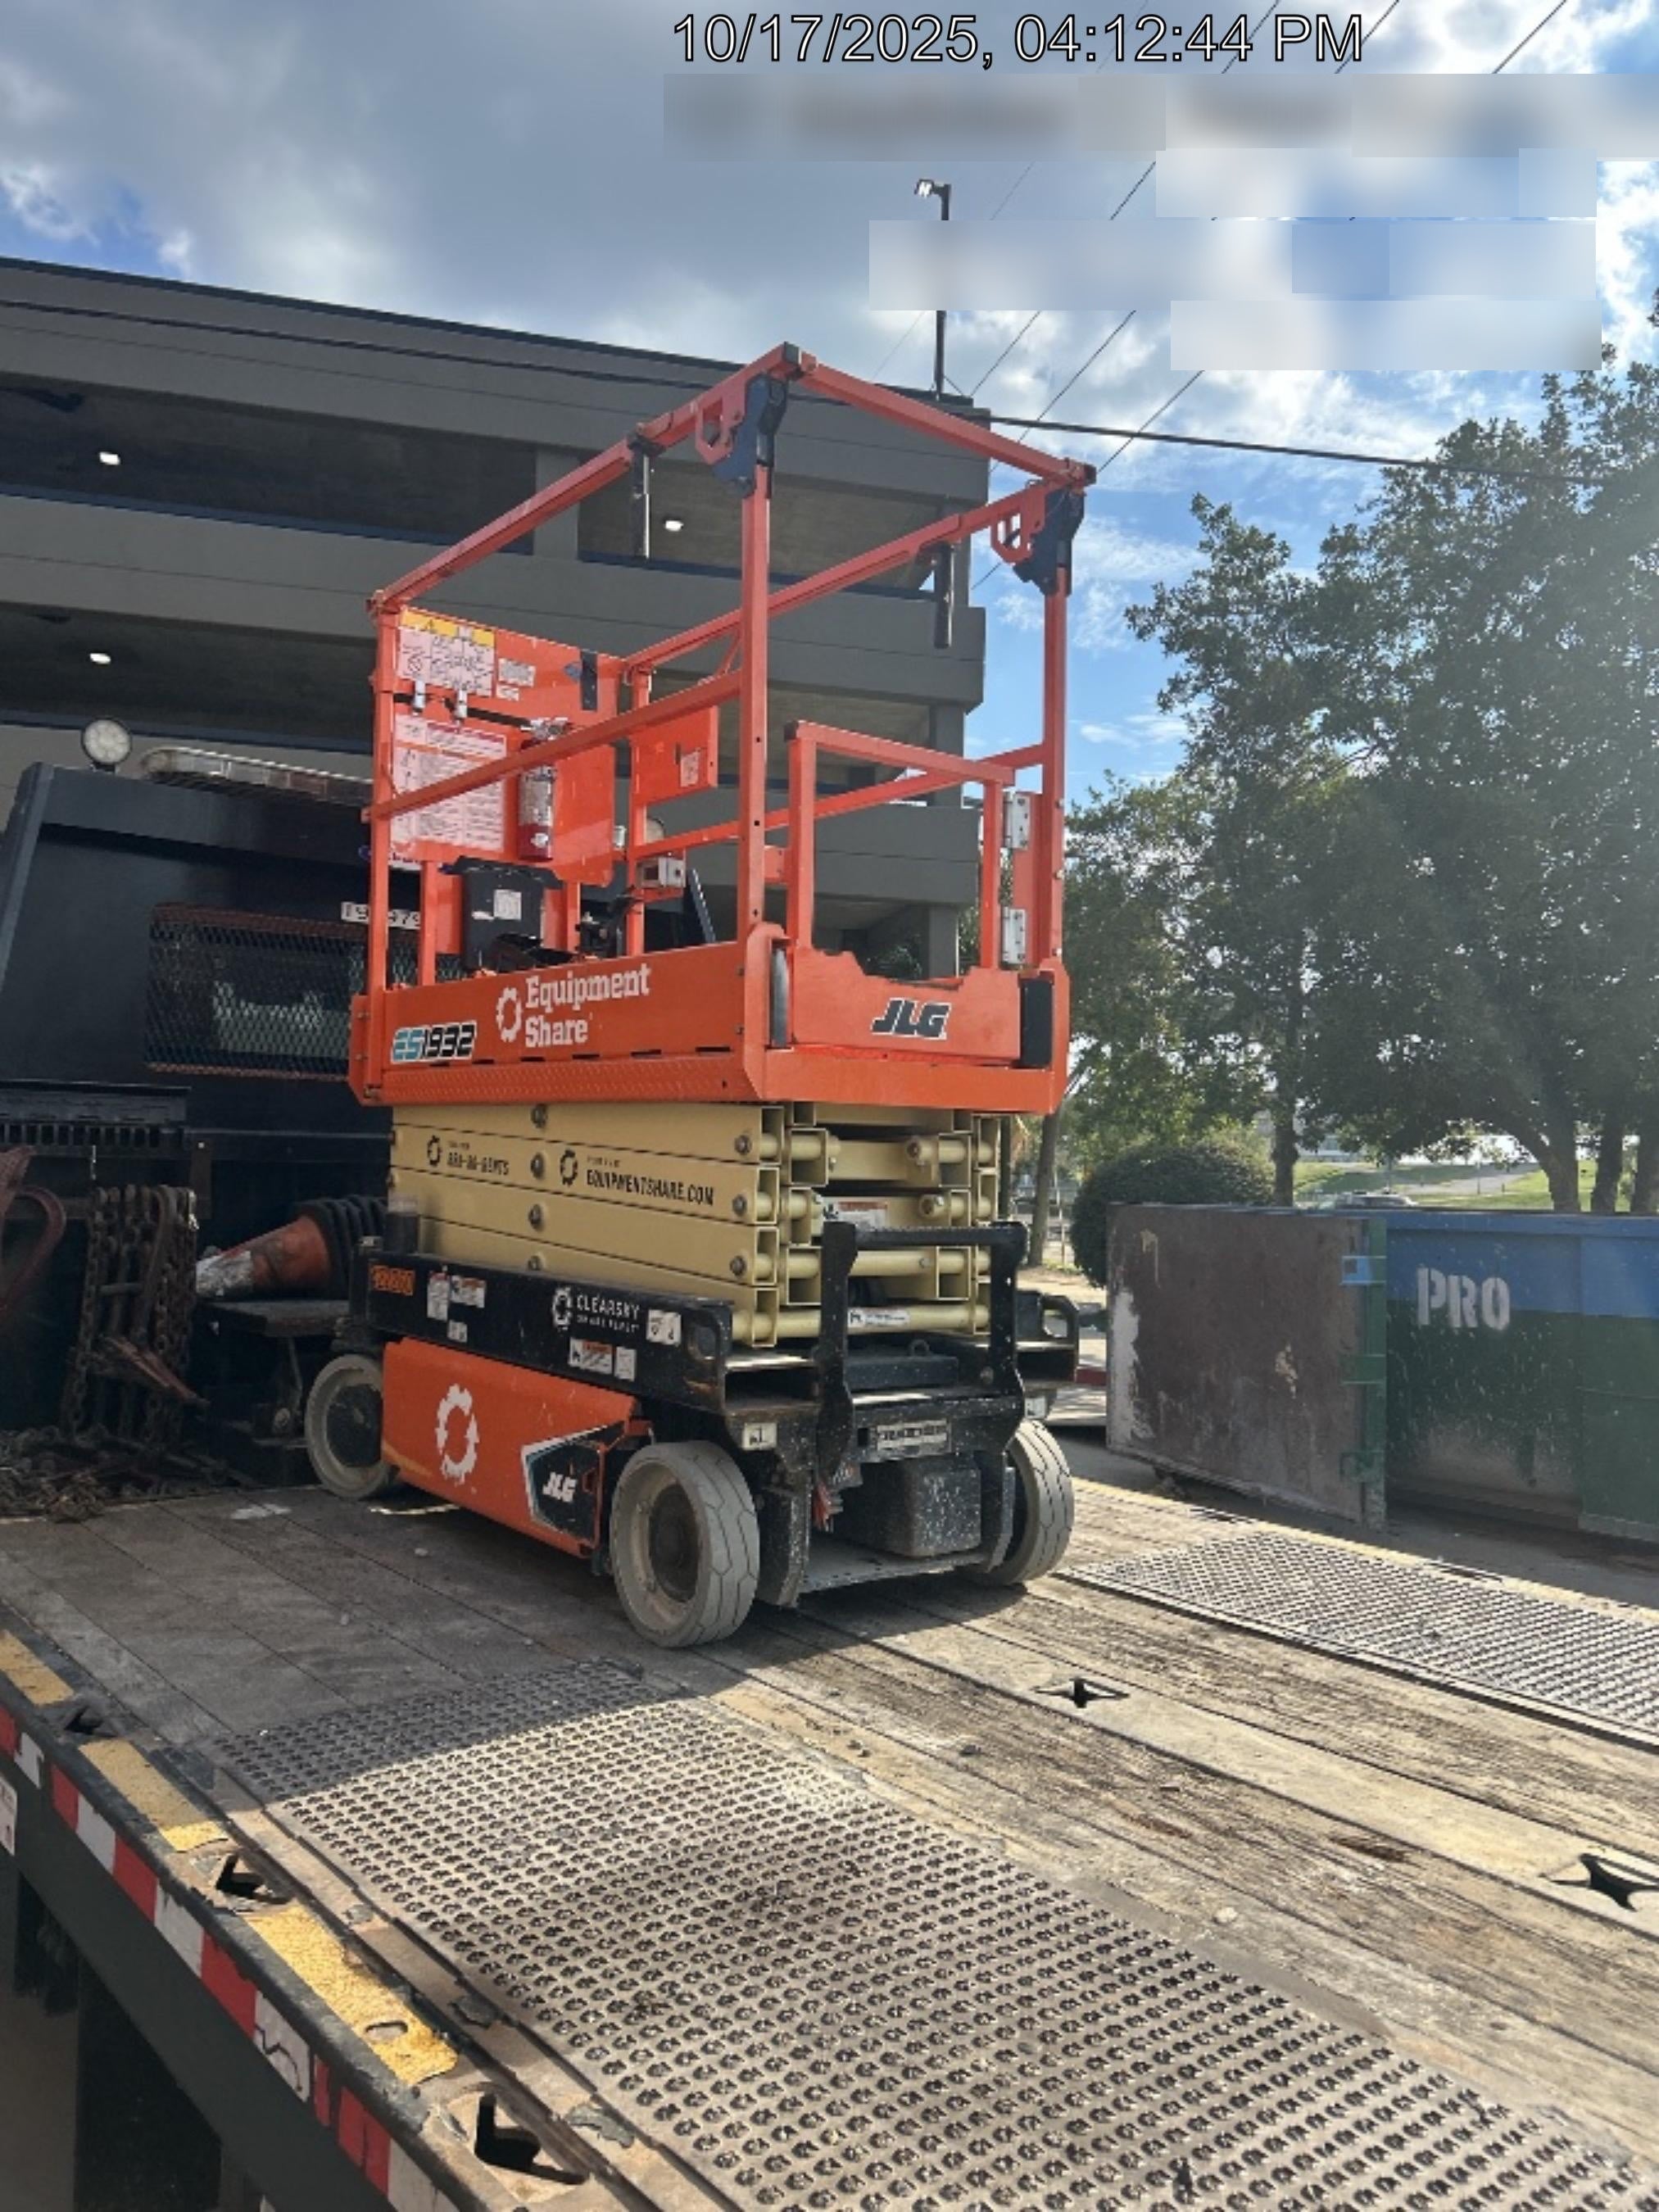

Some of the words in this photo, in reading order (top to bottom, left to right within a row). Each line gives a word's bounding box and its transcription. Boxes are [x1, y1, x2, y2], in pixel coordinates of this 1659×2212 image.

[525, 963, 651, 1013] Equipment
[525, 1014, 588, 1048] Share
[870, 997, 951, 1040] JLG
[392, 1022, 476, 1063] ES1932
[586, 1169, 714, 1206] EQUIPMENTSHARE.COM
[576, 1294, 640, 1320] CLEARSKY
[1416, 1267, 1510, 1330] PRO
[542, 1471, 578, 1503] JLG
